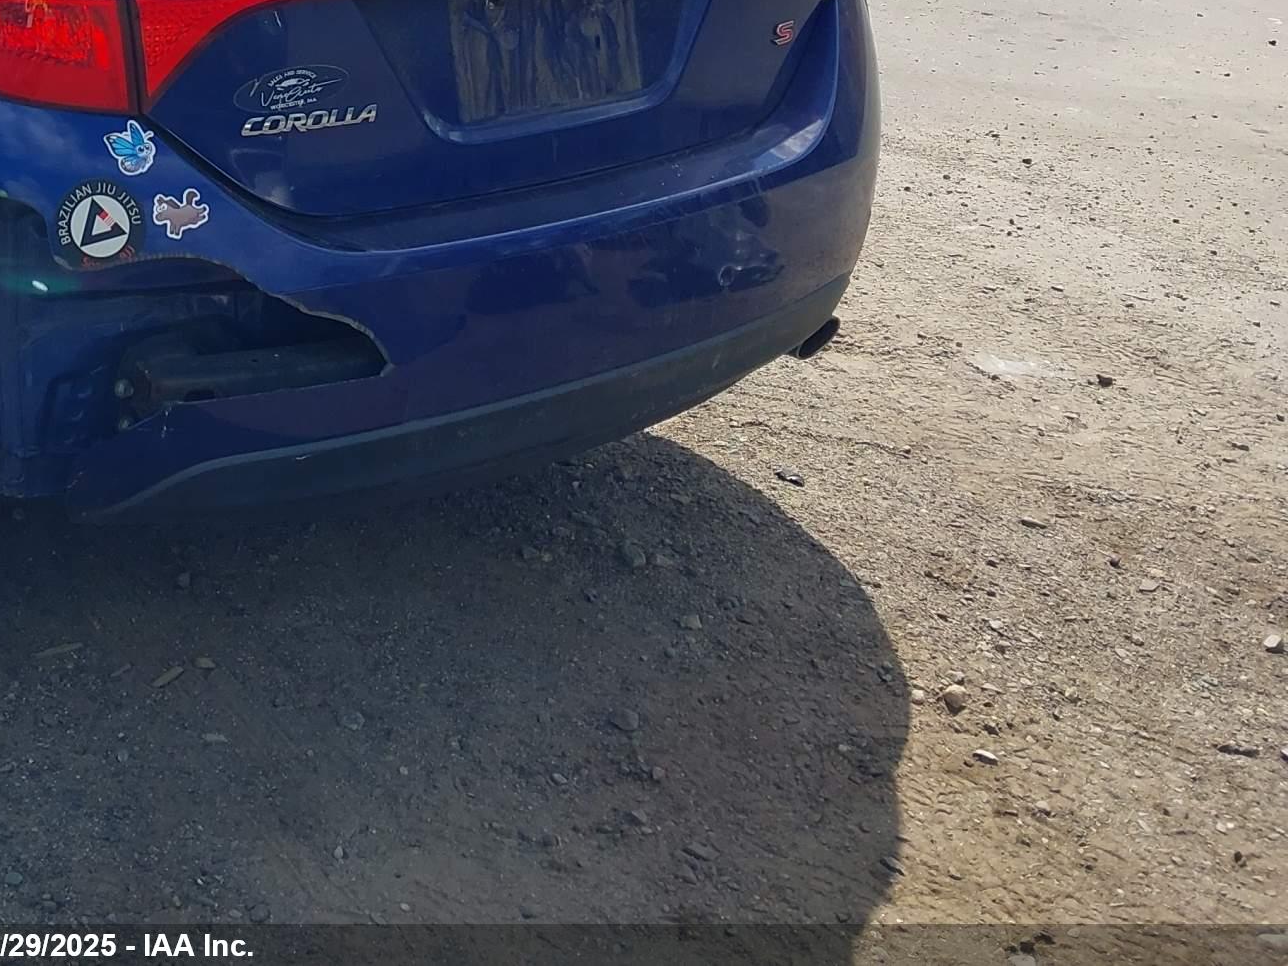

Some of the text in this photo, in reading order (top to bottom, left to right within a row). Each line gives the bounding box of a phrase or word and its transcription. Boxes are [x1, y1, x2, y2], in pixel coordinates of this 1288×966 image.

[773, 20, 794, 45] S
[241, 104, 377, 136] COROLLA
[58, 182, 142, 245] BRAZILIAN JIU JITSU
